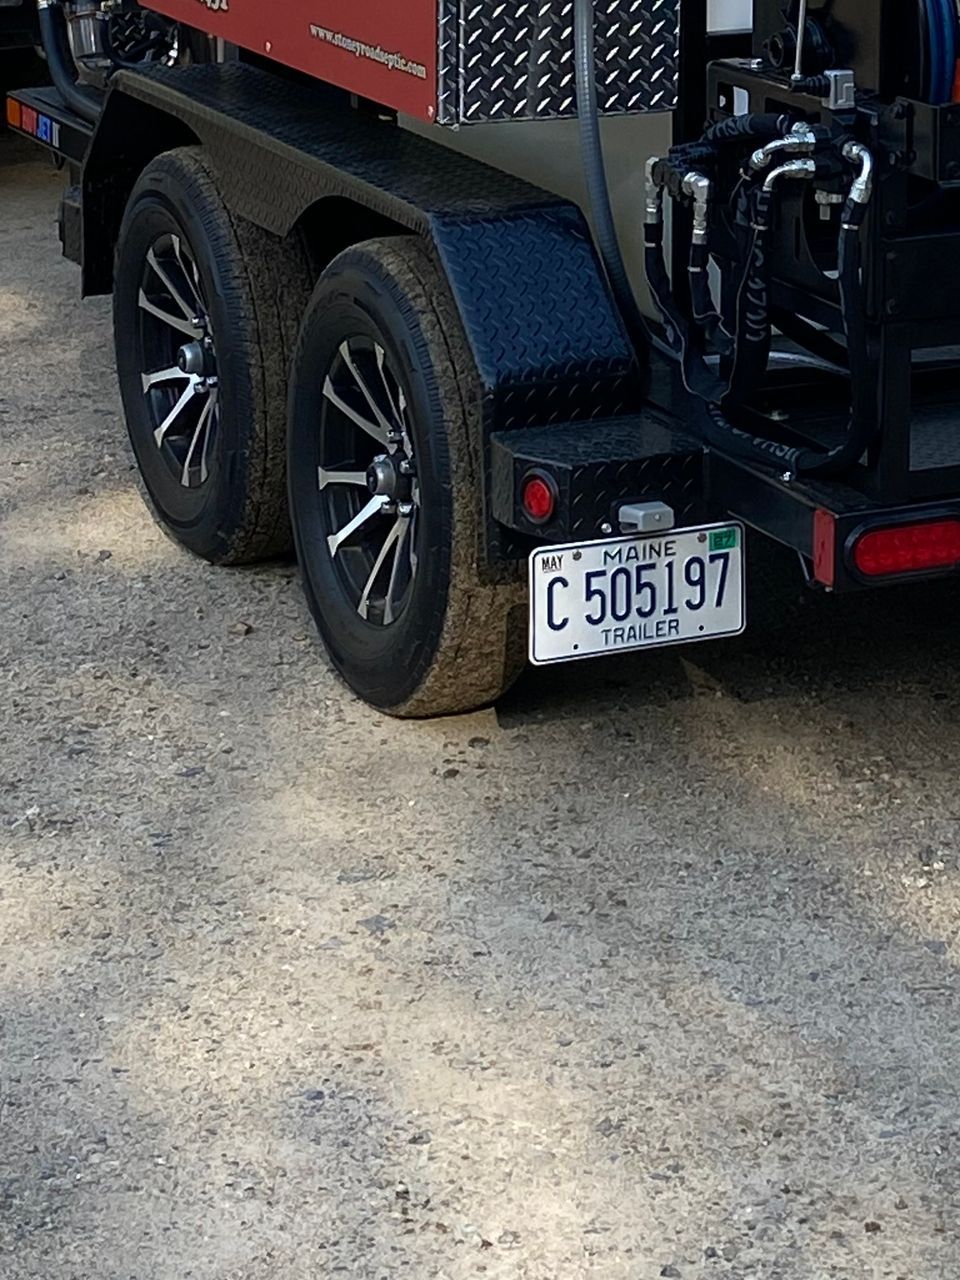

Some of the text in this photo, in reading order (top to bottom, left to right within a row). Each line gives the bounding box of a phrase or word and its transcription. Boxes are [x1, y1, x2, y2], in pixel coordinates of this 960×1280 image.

[310, 24, 426, 79] www.stoneyroadseptic.com
[542, 554, 564, 571] MAY
[603, 540, 677, 565] MAINE
[547, 552, 730, 631] C 505197
[601, 619, 680, 645] TRAILER
